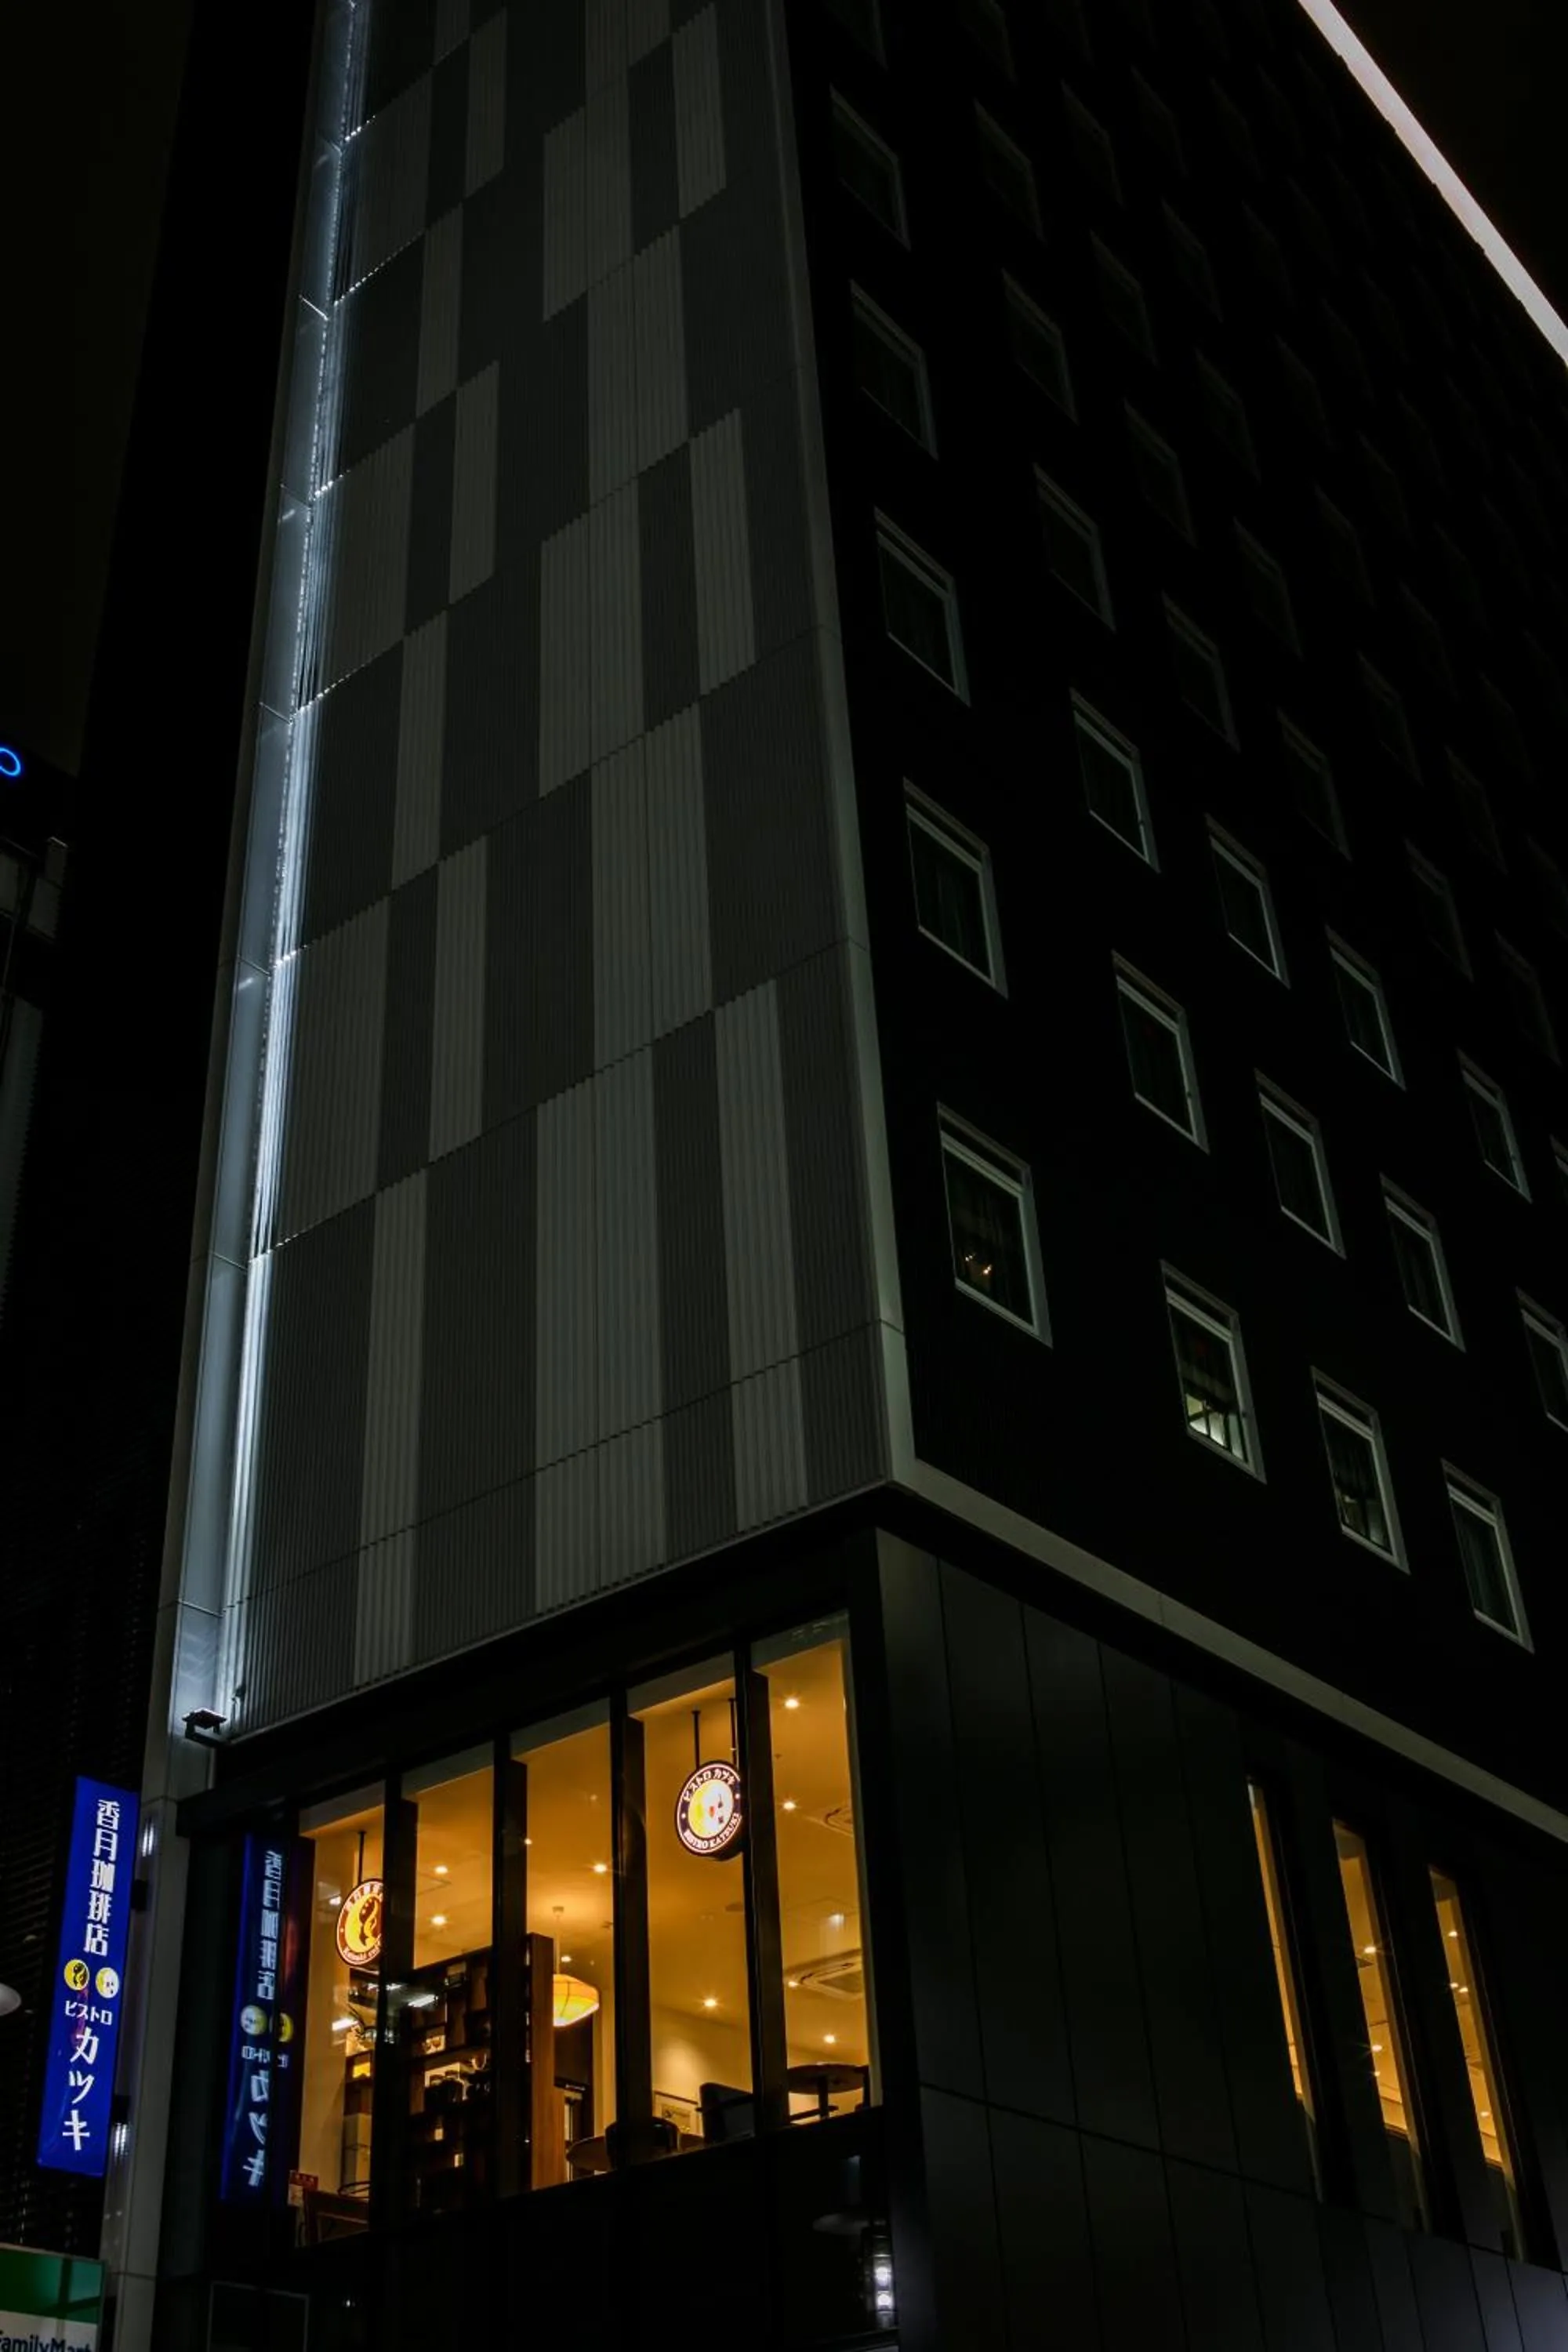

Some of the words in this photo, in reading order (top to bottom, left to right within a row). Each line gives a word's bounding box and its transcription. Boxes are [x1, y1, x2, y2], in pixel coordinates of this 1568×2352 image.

[83, 1798, 120, 1956] 香月珈琲店
[65, 2000, 113, 2025] ビストロ
[62, 2027, 100, 2151] カツキ
[0, 2330, 93, 2352] amilyMart
